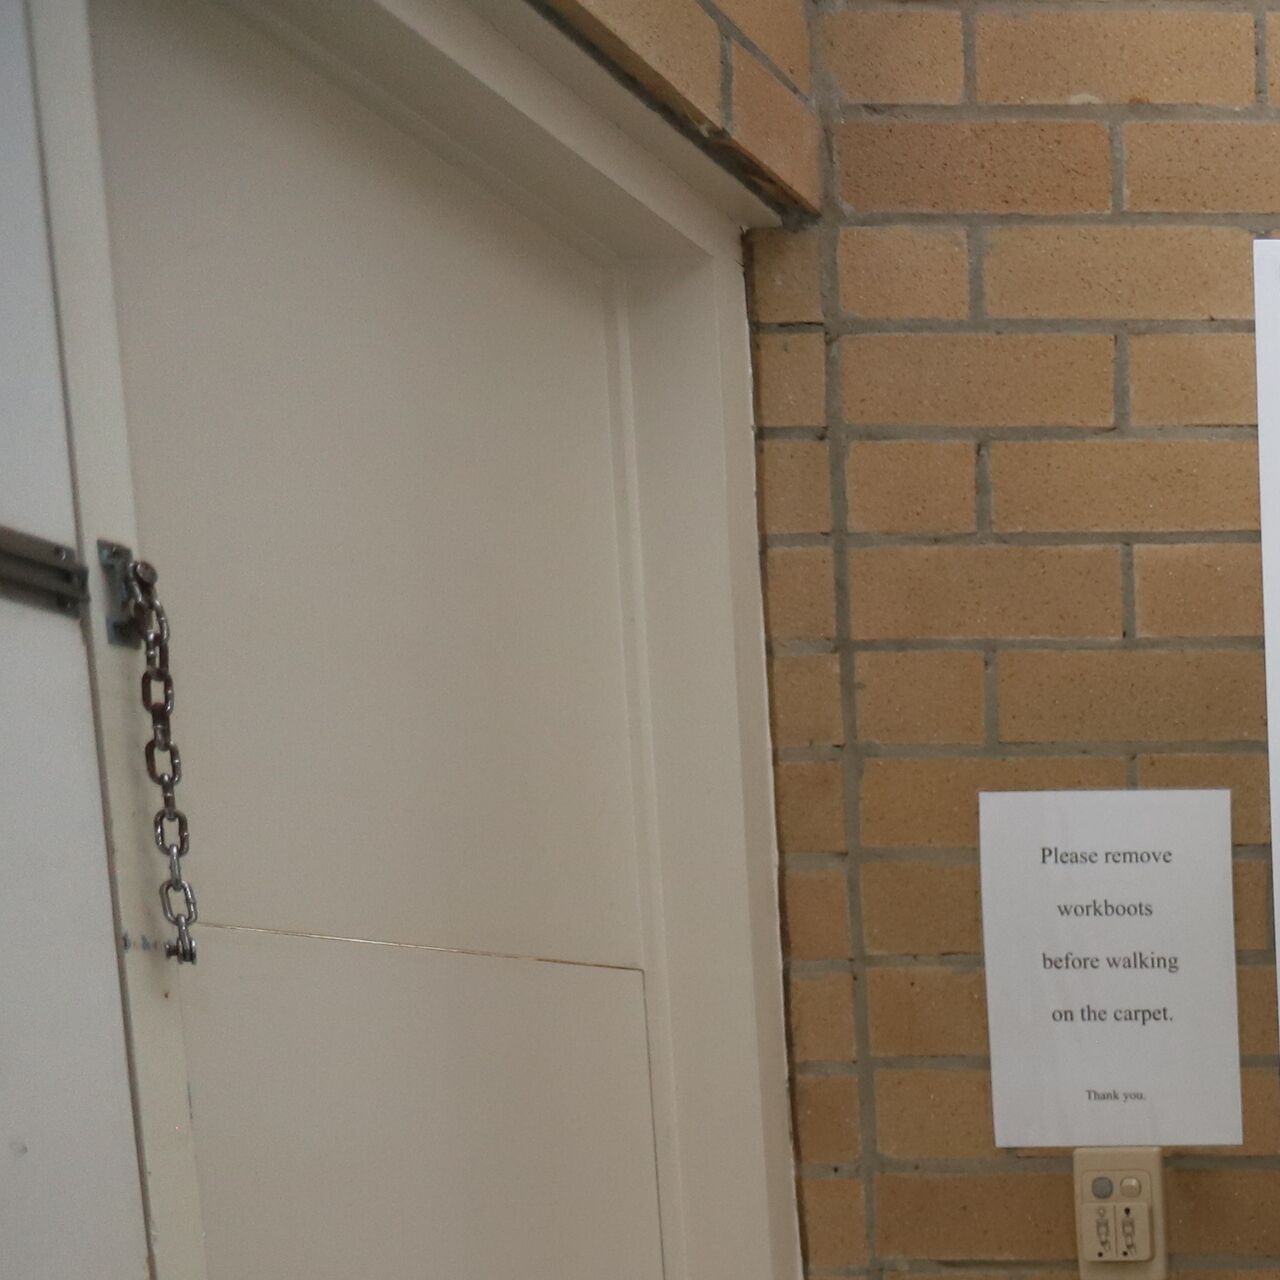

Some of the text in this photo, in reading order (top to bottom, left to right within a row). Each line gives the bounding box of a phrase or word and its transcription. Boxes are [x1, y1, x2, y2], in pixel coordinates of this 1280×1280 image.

[1040, 847, 1173, 865] Please remove
[1057, 899, 1153, 917] workboots
[1042, 951, 1180, 973] before walking
[1051, 1004, 1174, 1026] on the carpet.
[1085, 1089, 1147, 1103] Thank you.
